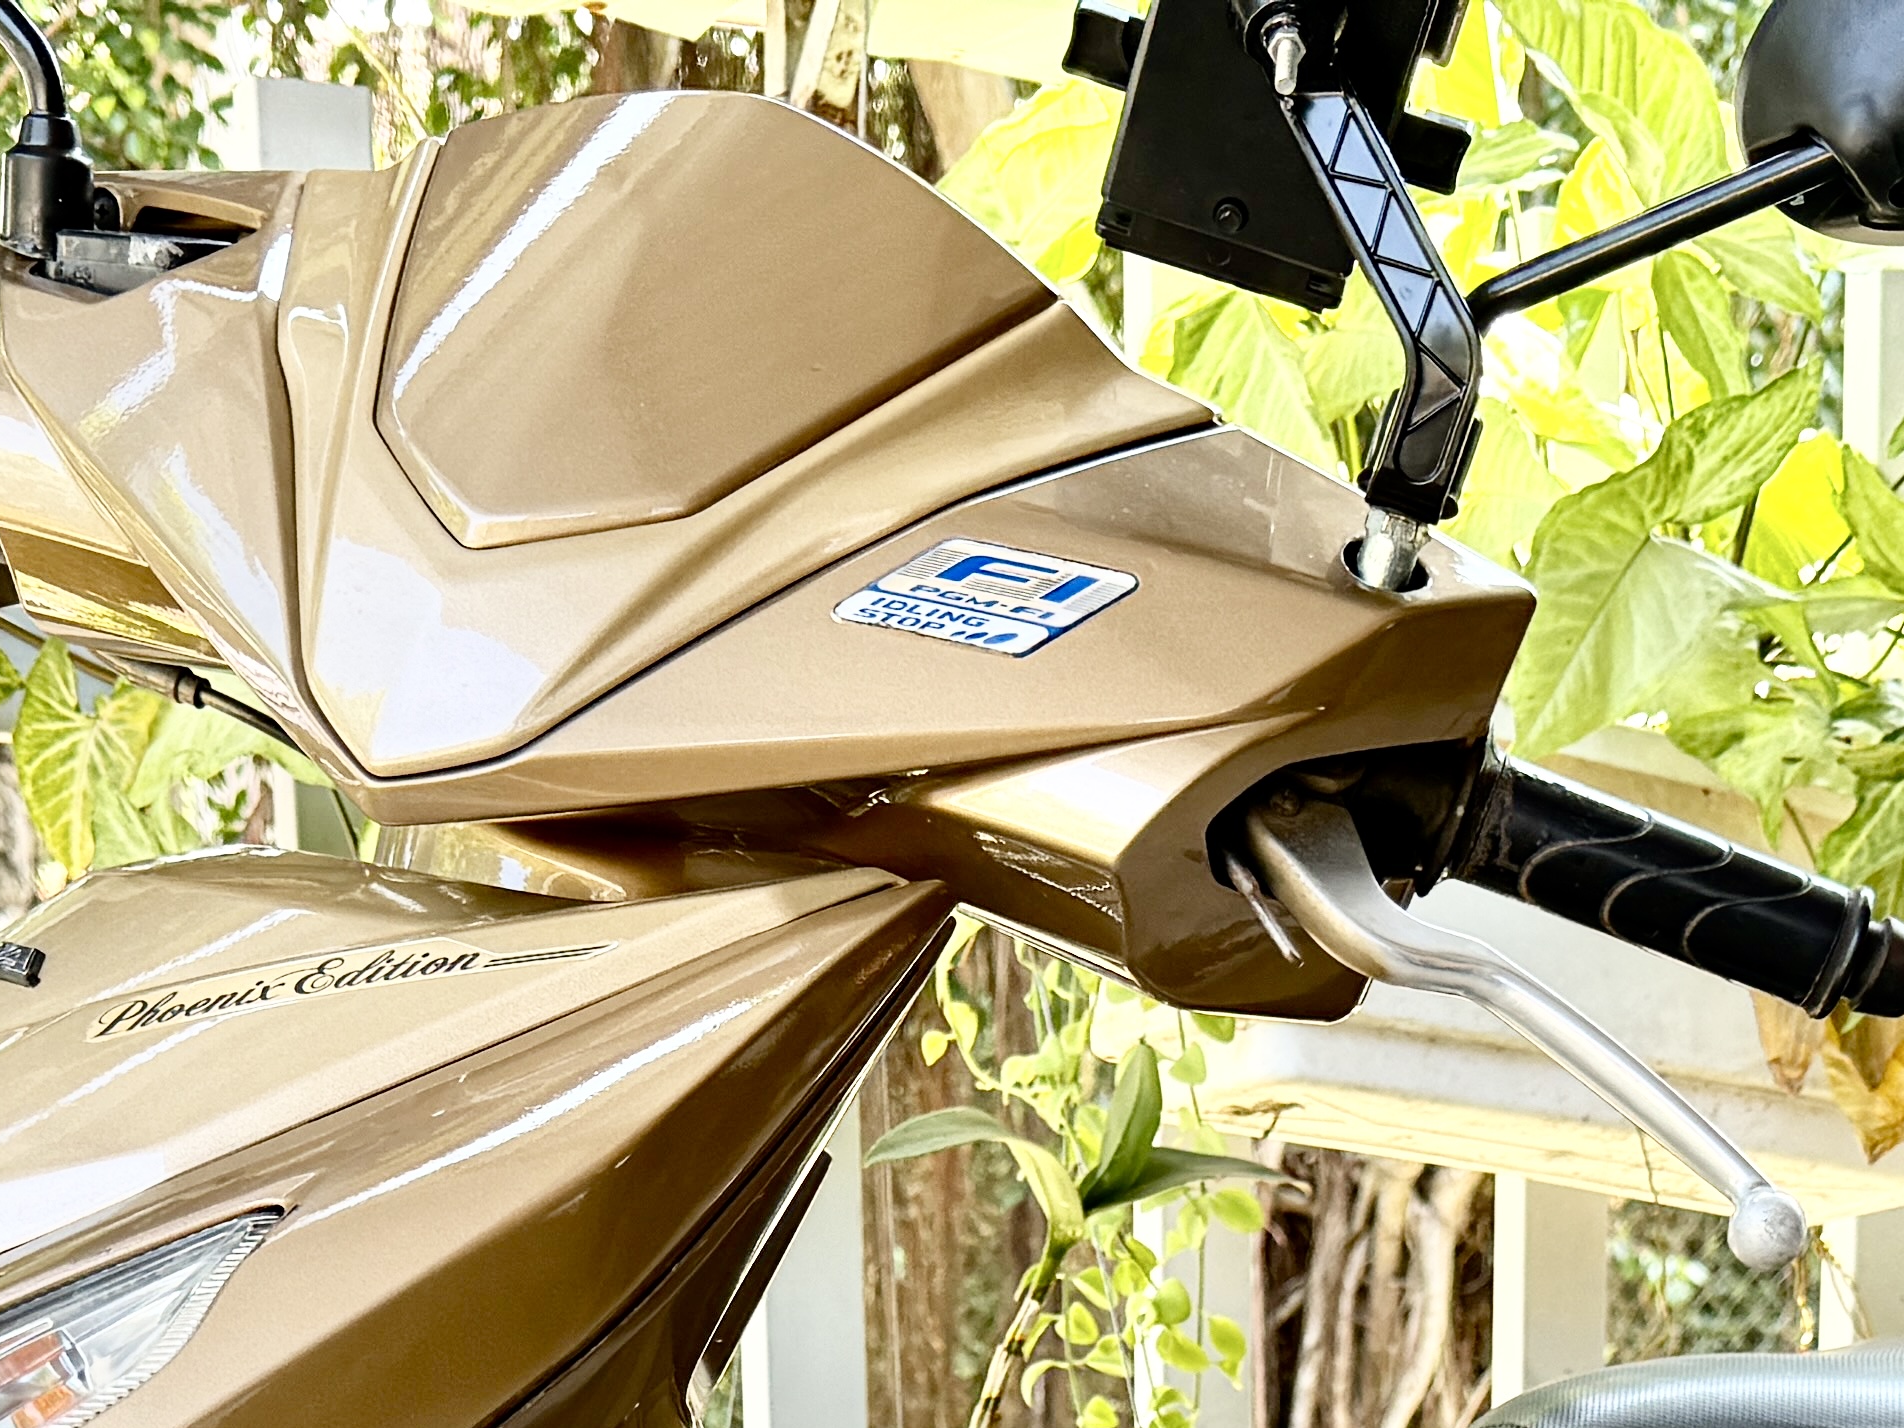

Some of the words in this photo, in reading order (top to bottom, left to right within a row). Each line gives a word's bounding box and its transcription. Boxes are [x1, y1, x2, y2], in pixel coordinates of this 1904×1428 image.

[935, 555, 1100, 603] FI
[852, 608, 946, 633] STOP
[871, 596, 991, 629] IDLING
[910, 583, 1057, 621] PGM-FI
[97, 978, 288, 1037] Phoenix
[294, 947, 483, 997] Edition
